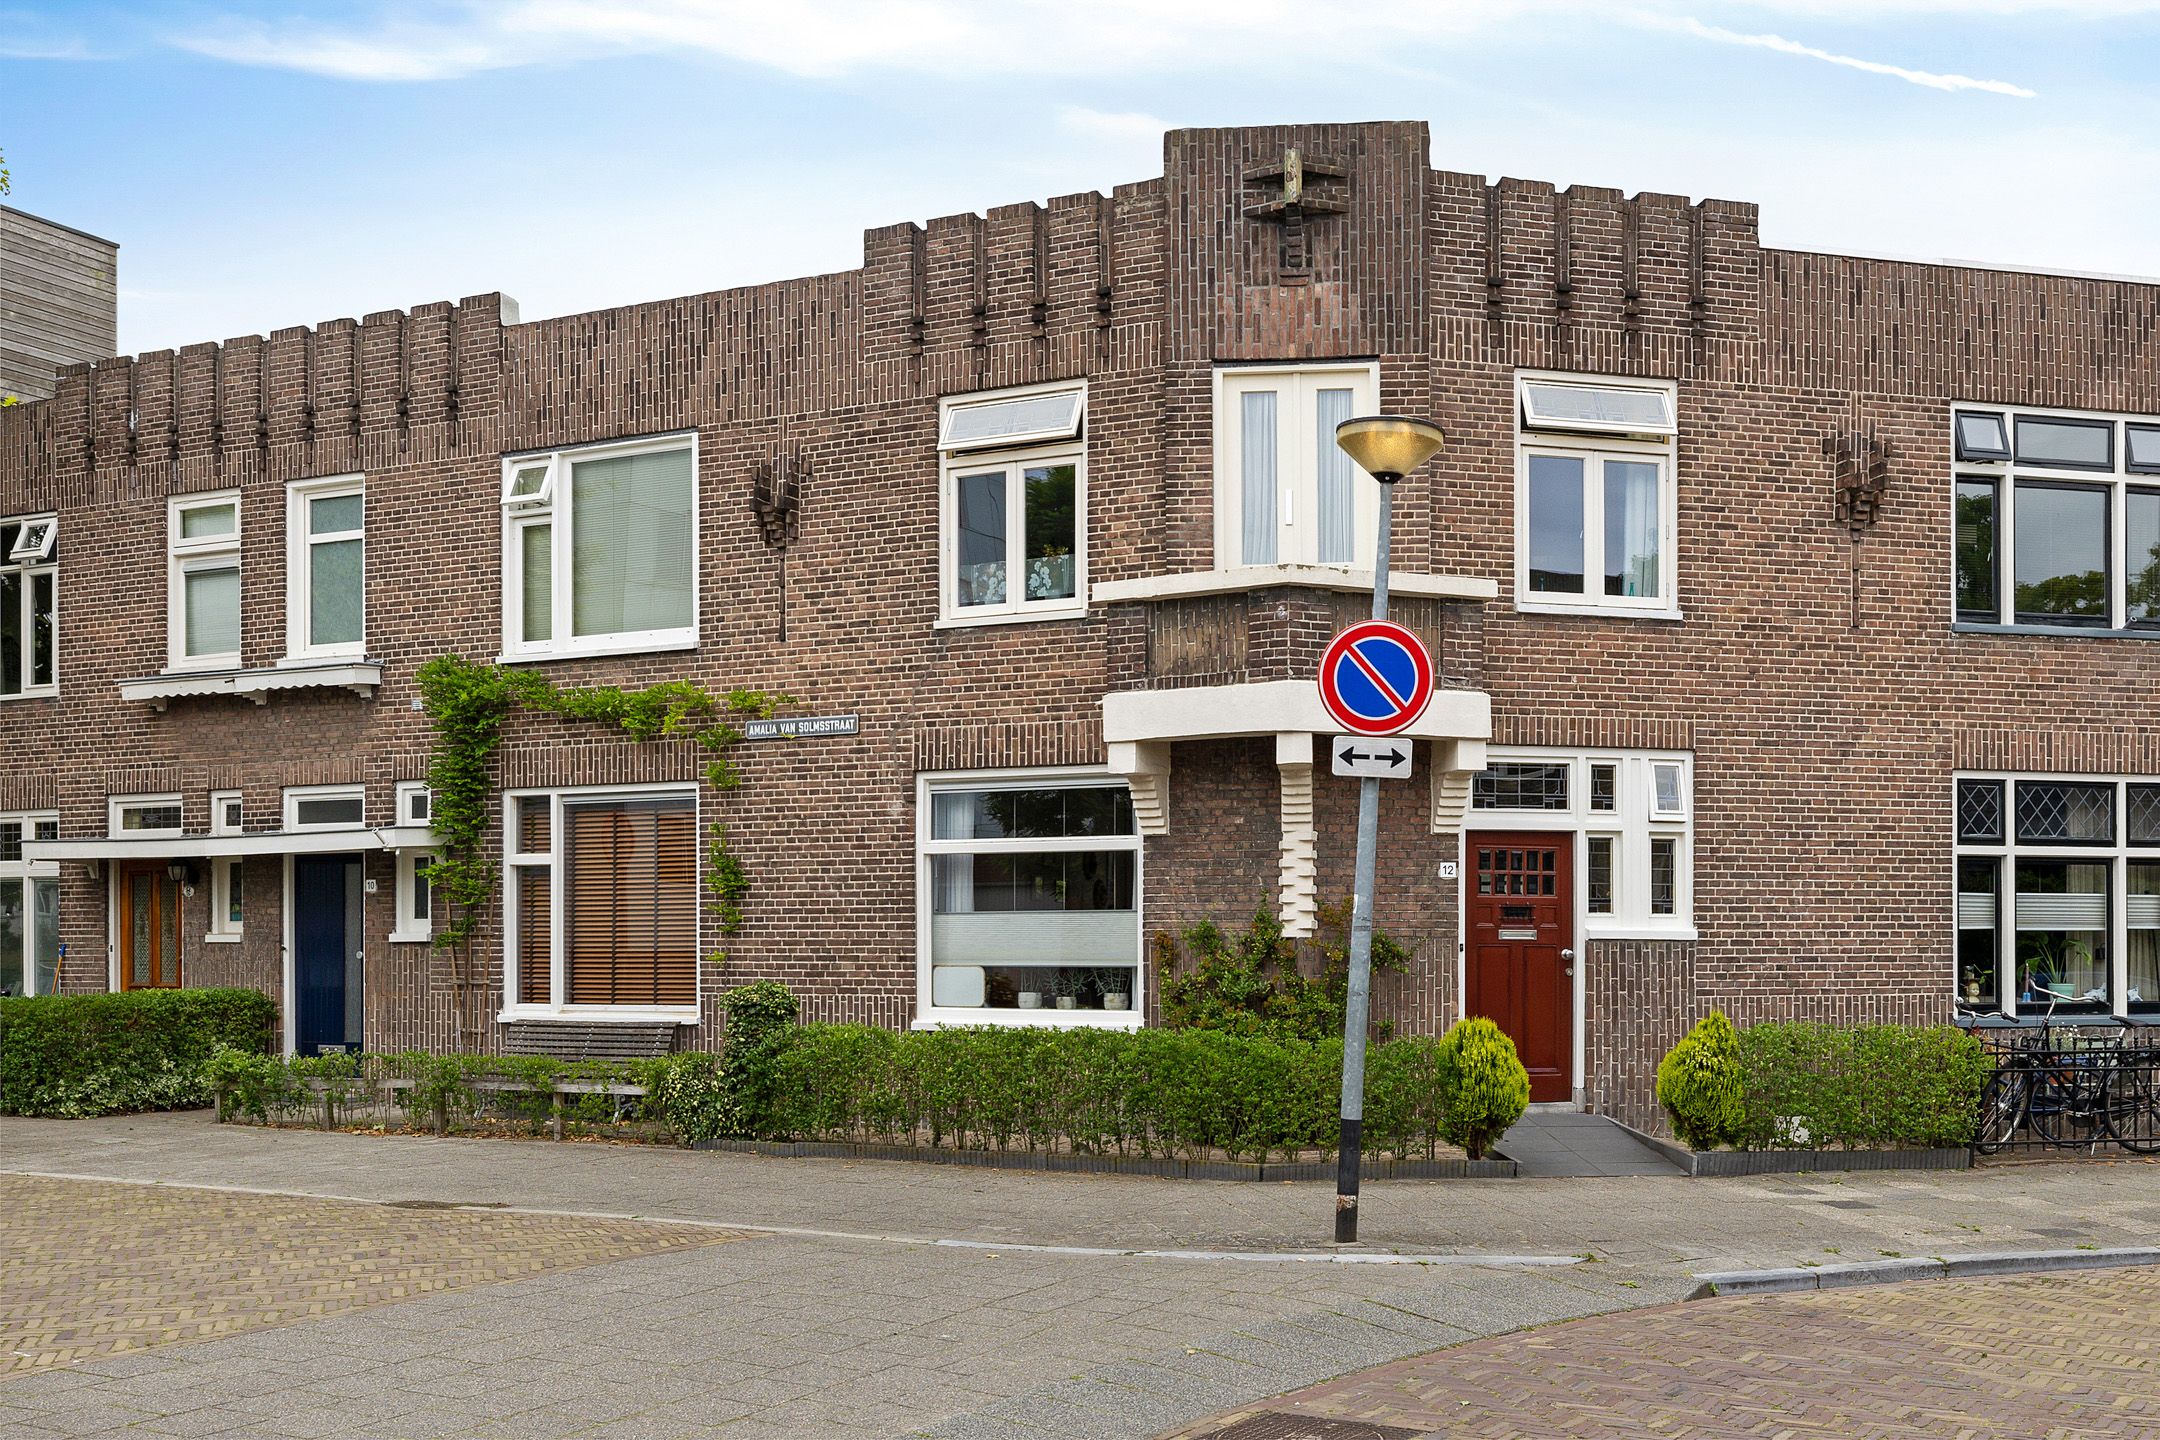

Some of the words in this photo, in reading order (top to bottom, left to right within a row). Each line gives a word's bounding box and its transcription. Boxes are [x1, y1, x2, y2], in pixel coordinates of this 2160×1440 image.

[749, 724, 777, 736] AMALIA
[780, 722, 796, 734] VAN
[798, 719, 855, 732] SOLMSSTRAAT
[1442, 865, 1454, 875] 12
[367, 881, 375, 890] 10
